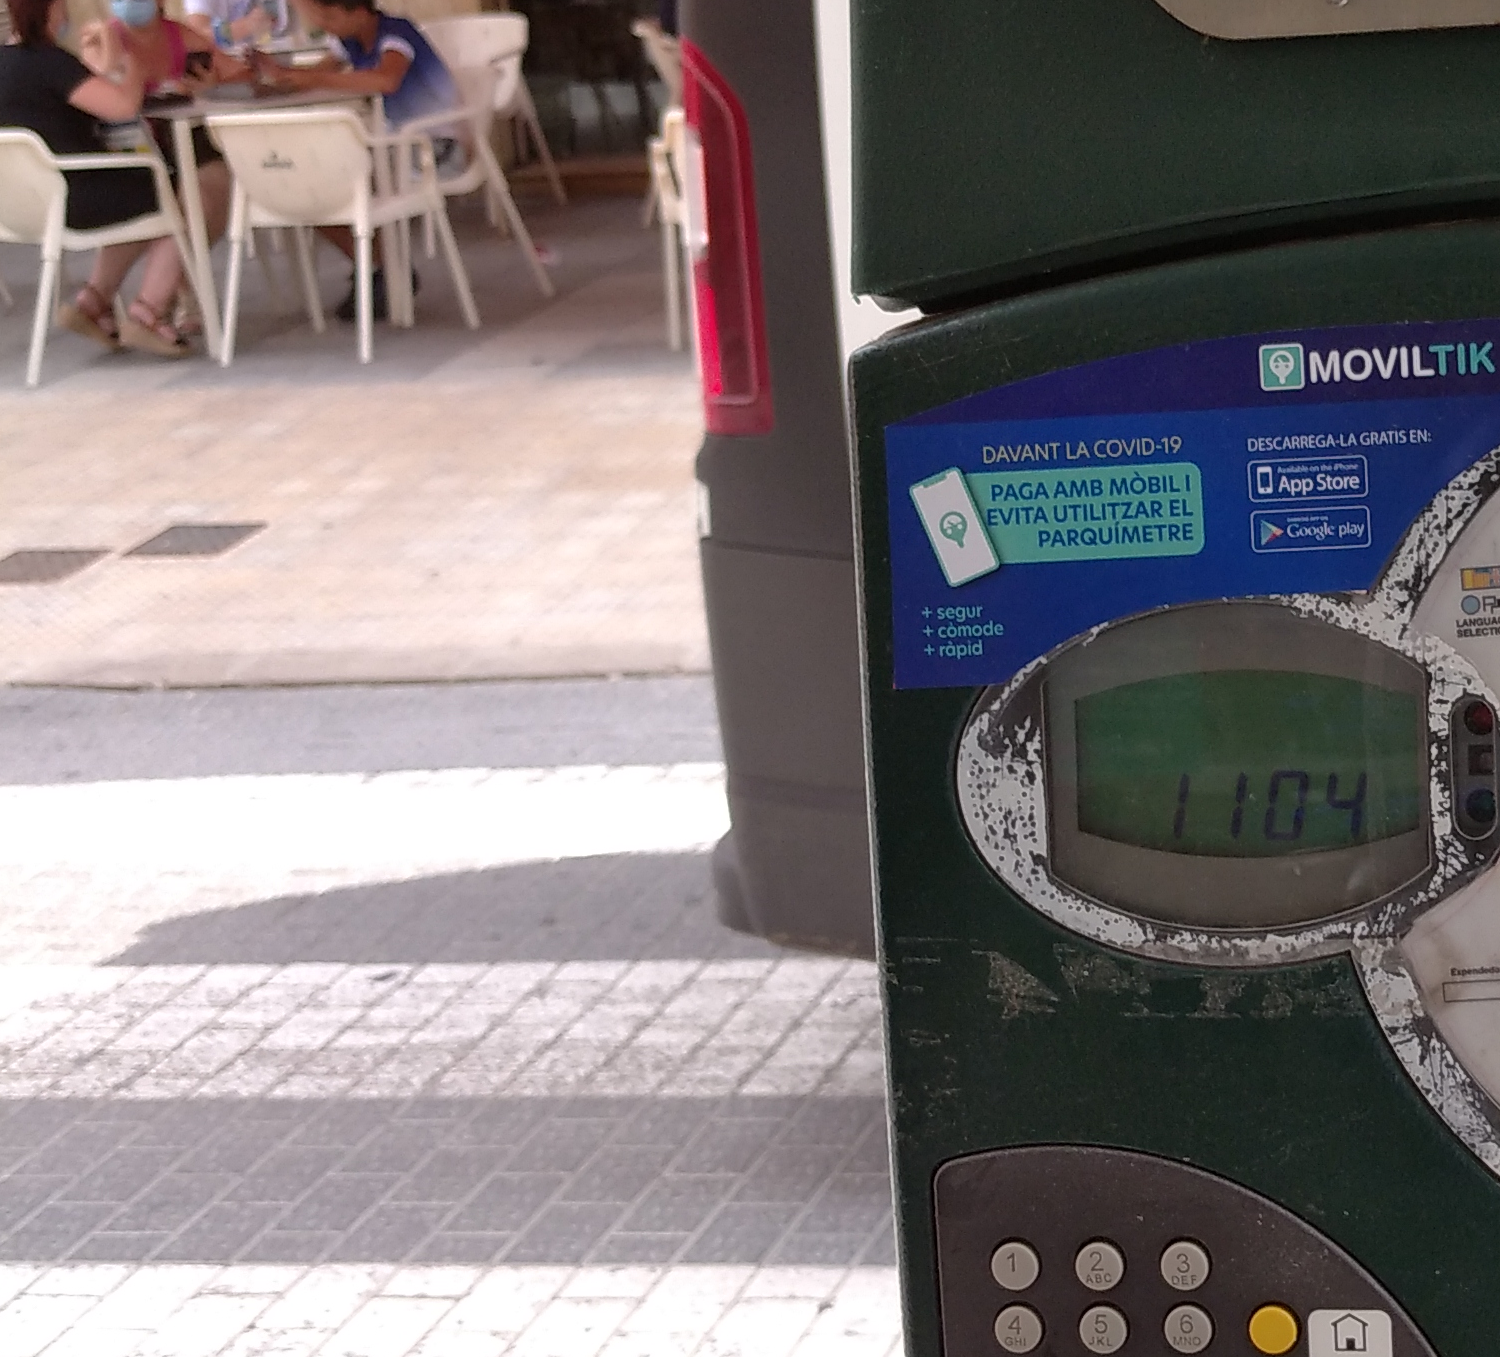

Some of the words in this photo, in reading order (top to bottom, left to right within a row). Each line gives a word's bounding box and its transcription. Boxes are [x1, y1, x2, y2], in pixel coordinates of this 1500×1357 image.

[1309, 342, 1496, 384] MOVILTIK
[983, 442, 1060, 464] DAVANT
[1066, 441, 1090, 460] LA
[1093, 435, 1182, 458] COVID-19
[1247, 433, 1358, 452] DESCARREGA-LA
[1359, 430, 1407, 446] GRATIS
[1409, 428, 1432, 443] EN:
[990, 482, 1049, 502] PAGA
[1053, 478, 1104, 500] AMB
[1109, 471, 1180, 496] MÒBIL
[1185, 474, 1191, 492] I
[1278, 475, 1314, 496] App
[1316, 473, 1360, 491] Store
[986, 505, 1049, 527] EVITA
[1053, 500, 1164, 523] UTILITZAR
[1169, 498, 1194, 517] EL
[1038, 521, 1194, 549] PARQUÍMETRE
[1287, 521, 1335, 542] Google
[1338, 521, 1365, 539] play
[936, 605, 984, 623] segur
[937, 620, 1004, 638] còmode
[940, 640, 983, 660] ràpid
[1006, 1252, 1016, 1272] 1
[1089, 1251, 1104, 1272] 2
[1176, 1253, 1190, 1273] 3
[1085, 1273, 1112, 1284] ABC
[1171, 1274, 1197, 1286] DEF
[1008, 1315, 1022, 1335] 4
[1094, 1314, 1108, 1334] 5
[1180, 1314, 1194, 1334] 6
[1004, 1336, 1027, 1347] GHI
[1088, 1336, 1113, 1347] JKL
[1173, 1336, 1202, 1347] MNO
